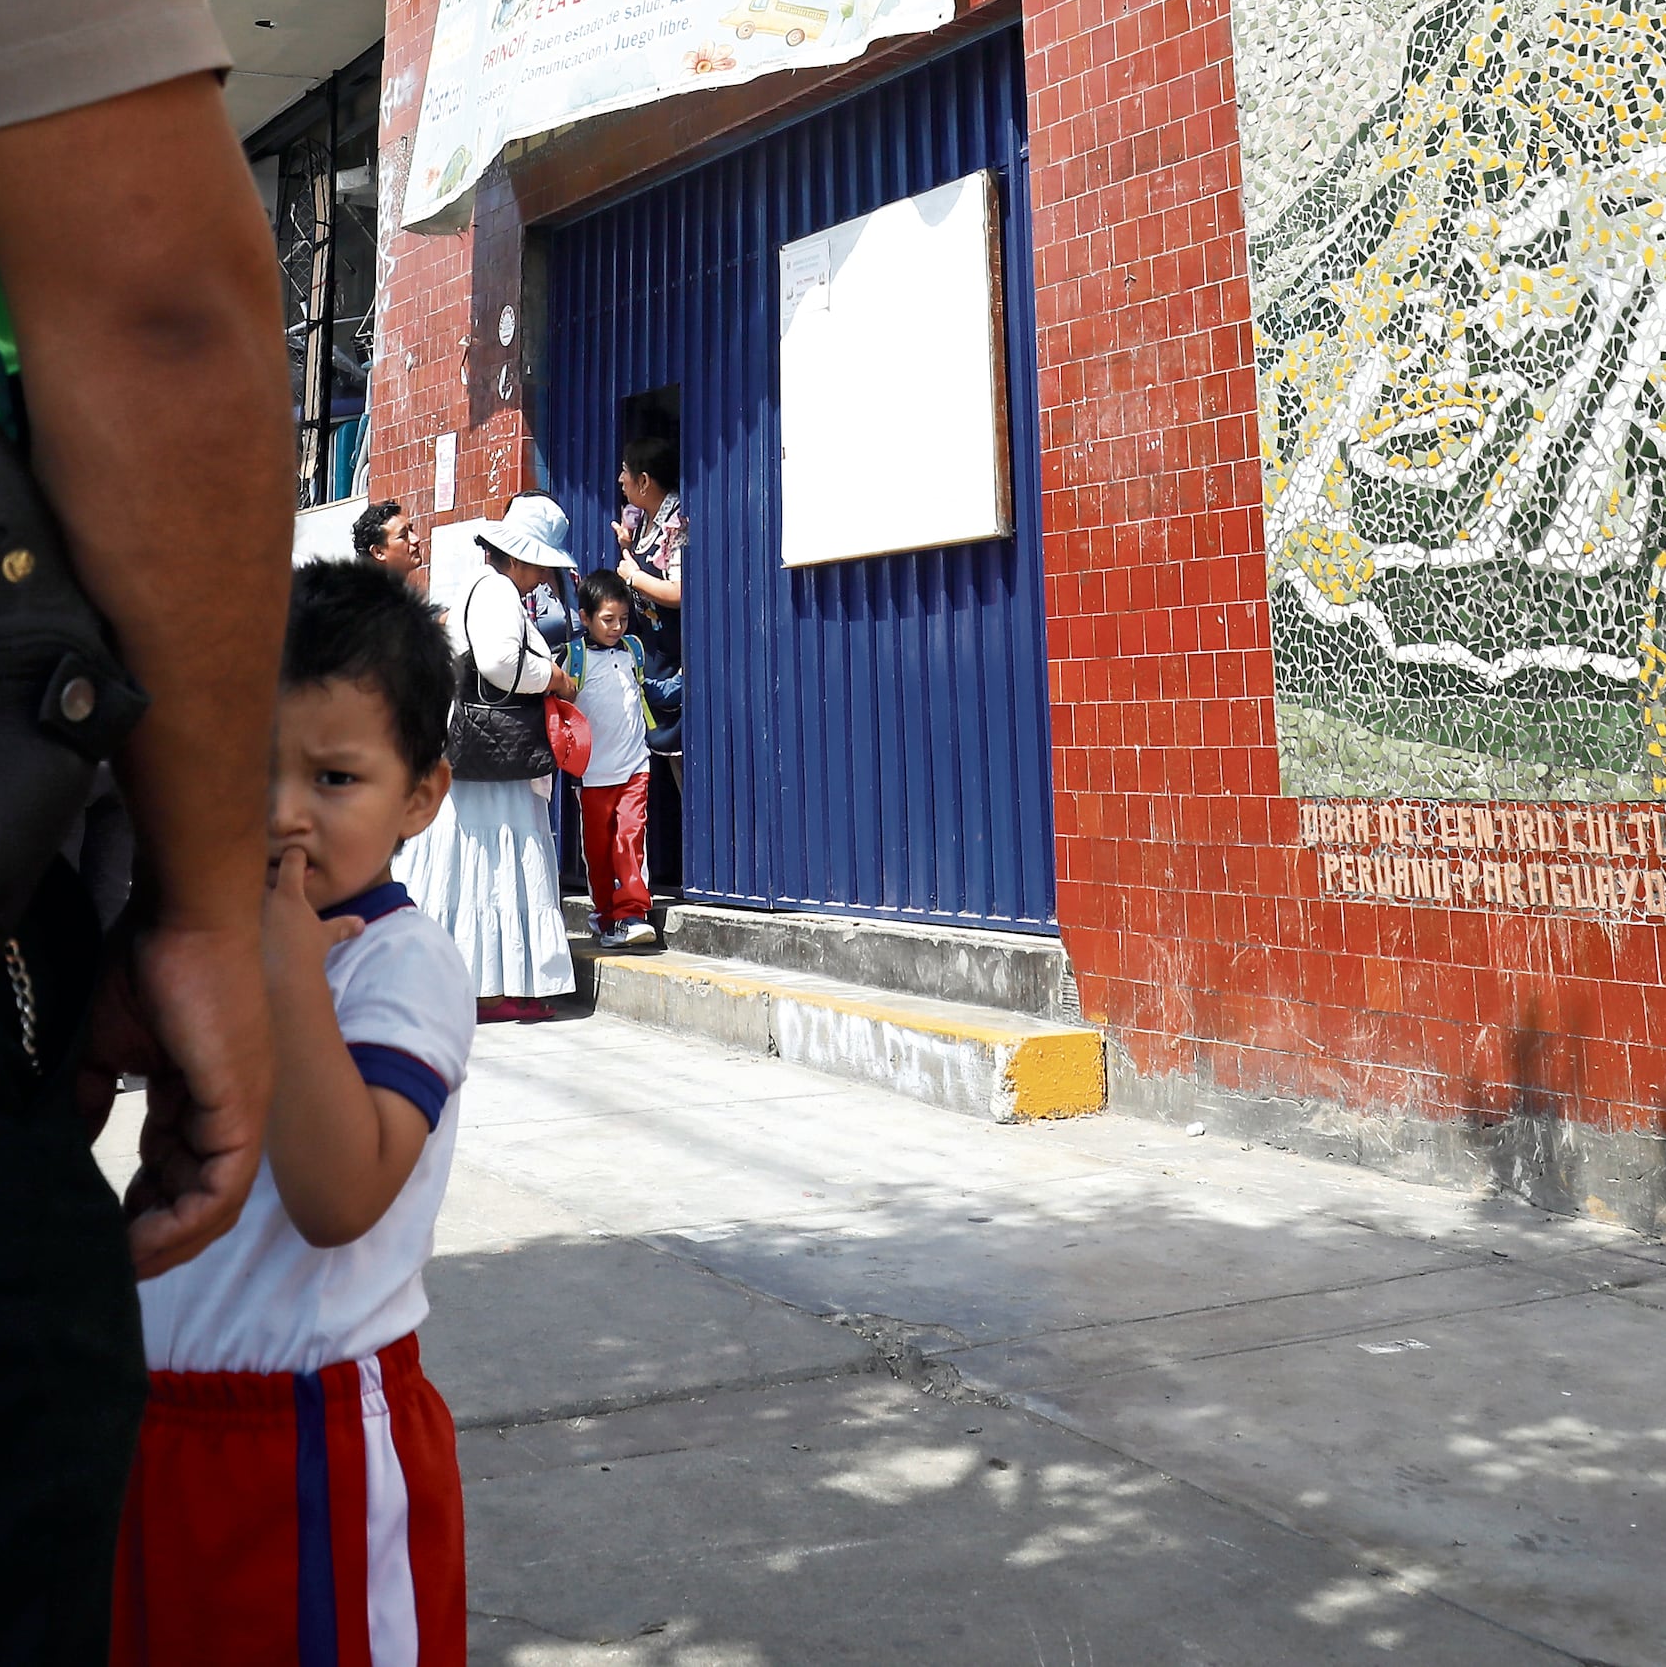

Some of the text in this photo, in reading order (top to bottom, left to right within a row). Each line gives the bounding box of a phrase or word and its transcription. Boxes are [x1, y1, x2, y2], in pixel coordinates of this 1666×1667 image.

[565, 18, 604, 42] estado
[606, 9, 620, 26] de
[614, 28, 654, 51] Juego
[1302, 804, 1369, 844] OBRA
[1379, 805, 1433, 847] DEL
